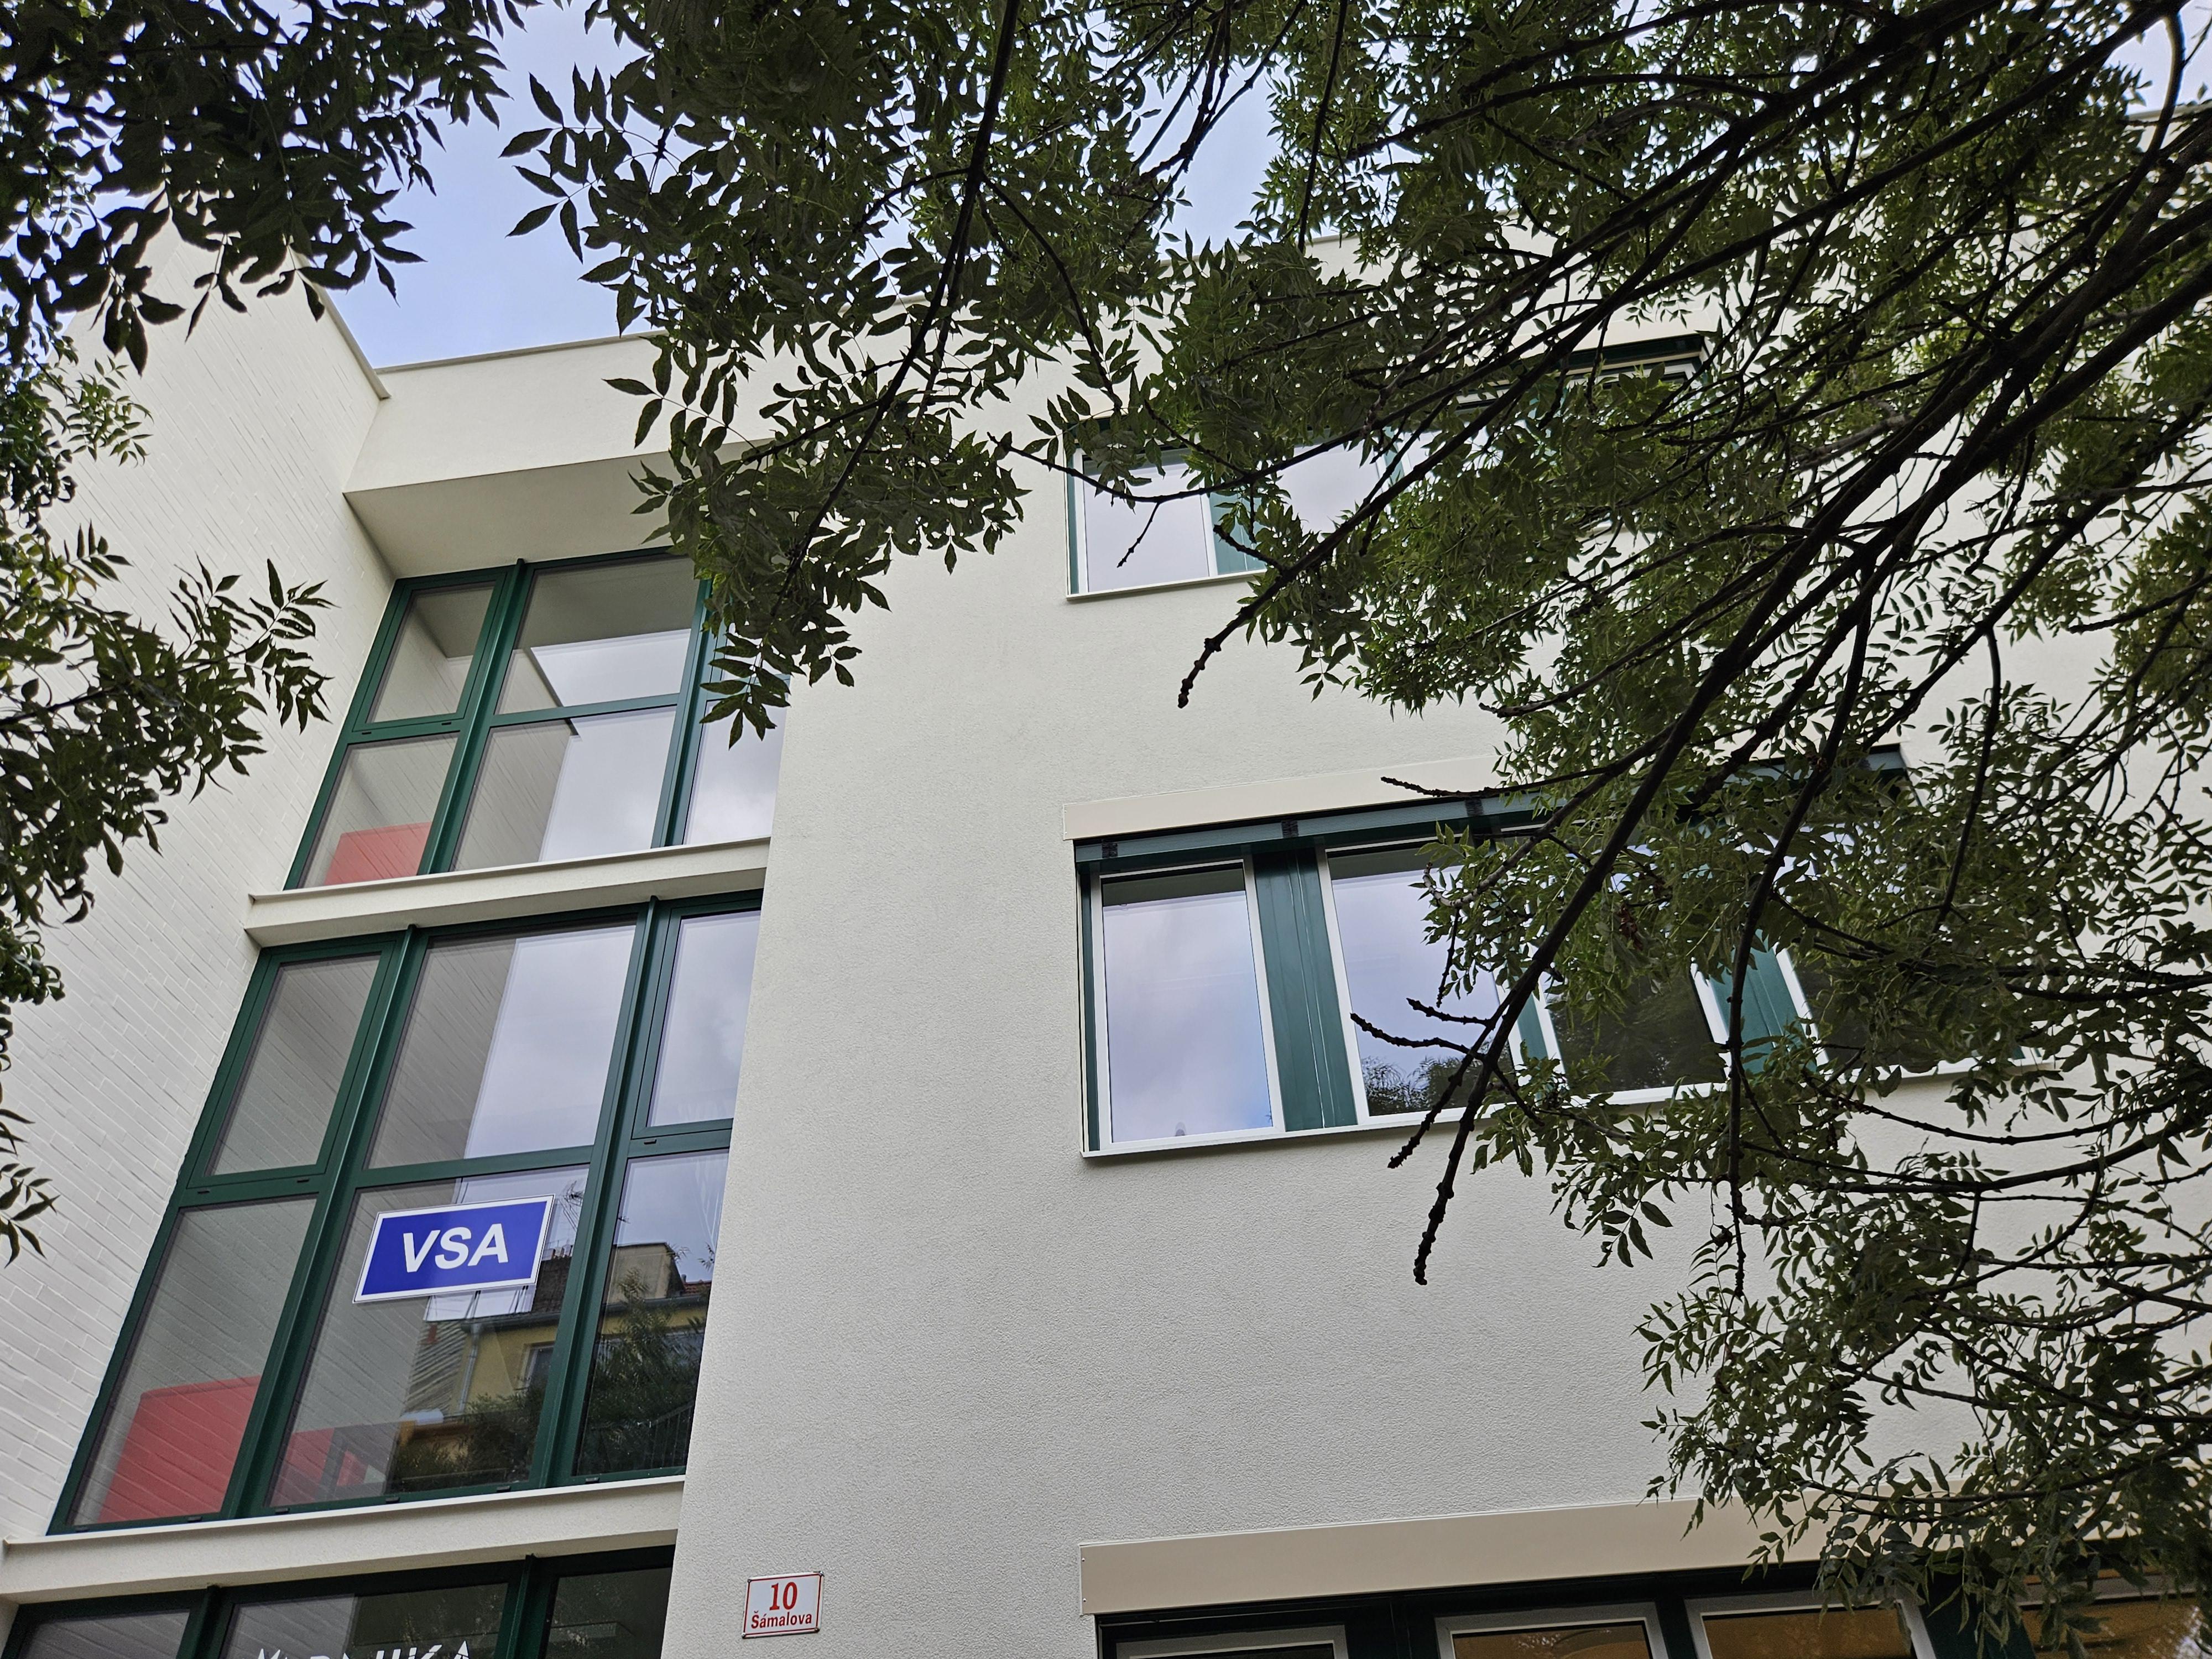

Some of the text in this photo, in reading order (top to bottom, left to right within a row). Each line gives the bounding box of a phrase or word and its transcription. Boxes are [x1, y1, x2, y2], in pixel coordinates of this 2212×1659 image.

[403, 1223, 508, 1272] VSA
[769, 1582, 797, 1610] 10
[751, 1610, 812, 1629] Šámalova
